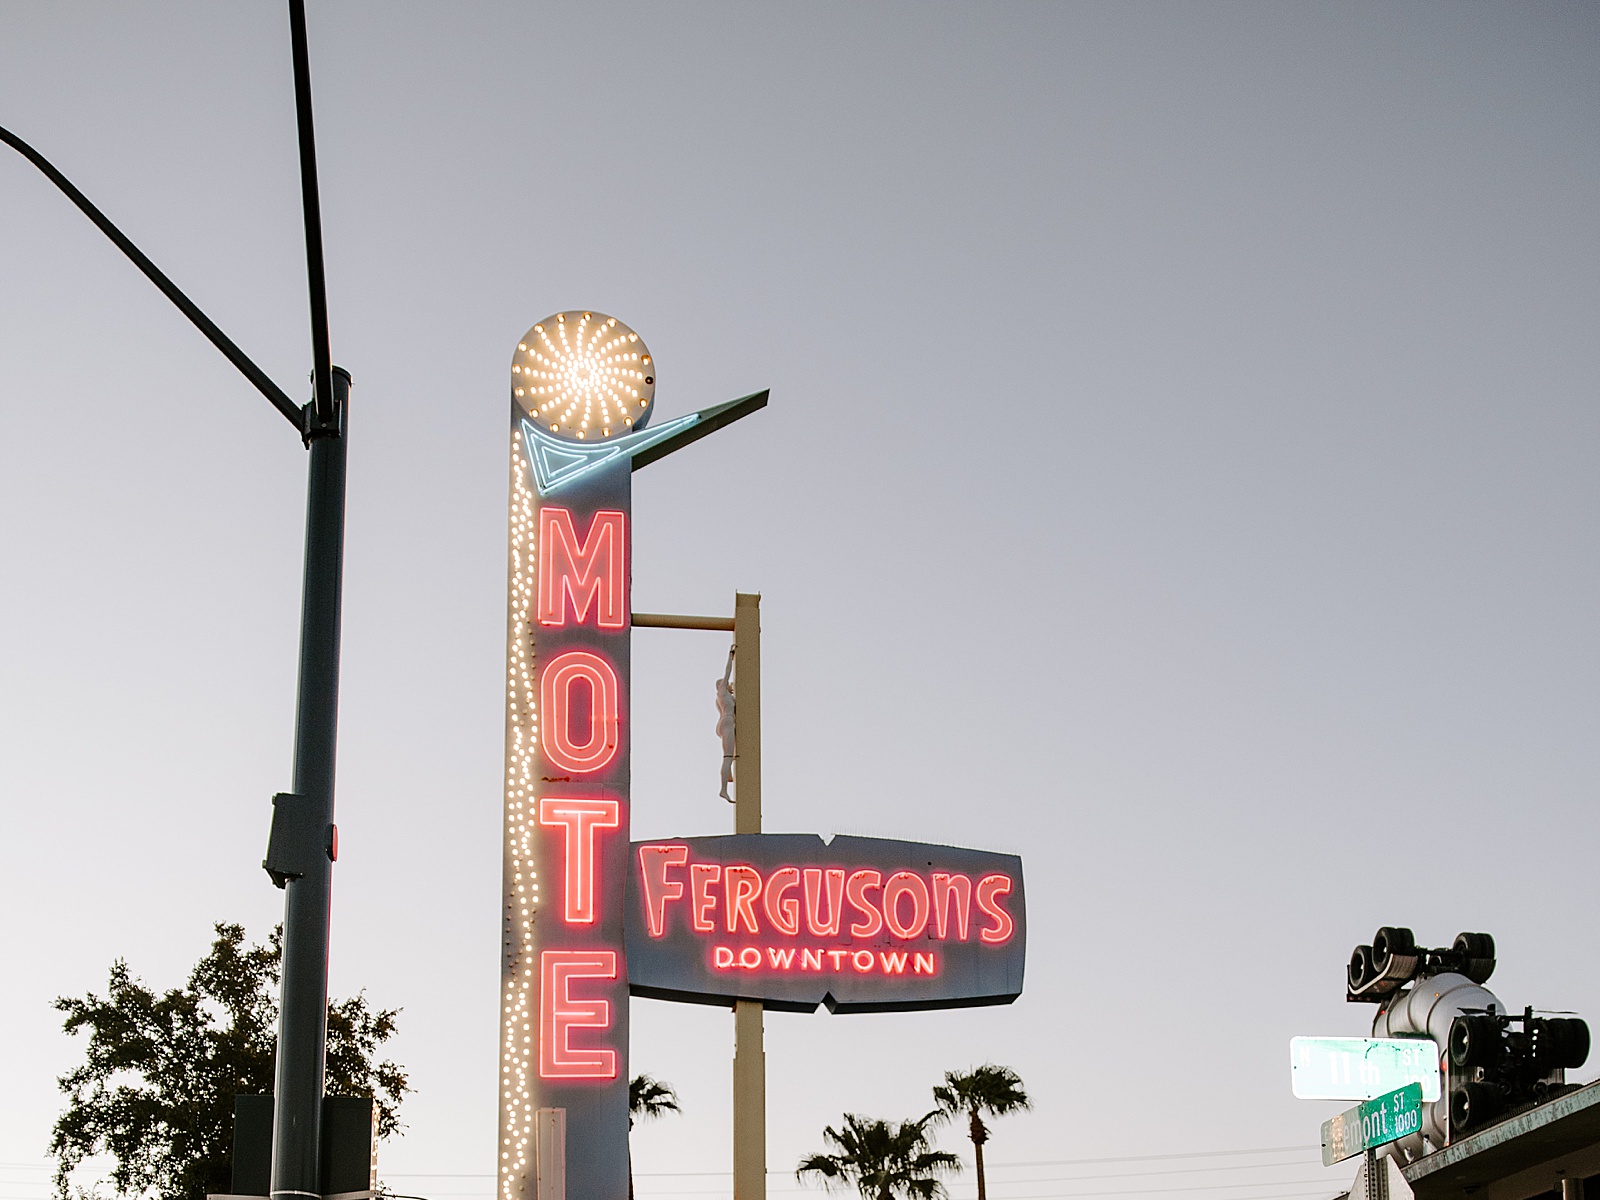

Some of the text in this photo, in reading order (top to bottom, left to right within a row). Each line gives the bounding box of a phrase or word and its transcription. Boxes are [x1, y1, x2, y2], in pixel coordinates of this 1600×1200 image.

[714, 946, 935, 975] DOWNTOWN
[1300, 1046, 1311, 1067] N
[1402, 1048, 1422, 1066] ST
[1334, 1102, 1388, 1152] emont
[1394, 1091, 1405, 1112] ST
[1395, 1109, 1417, 1133] 1000
